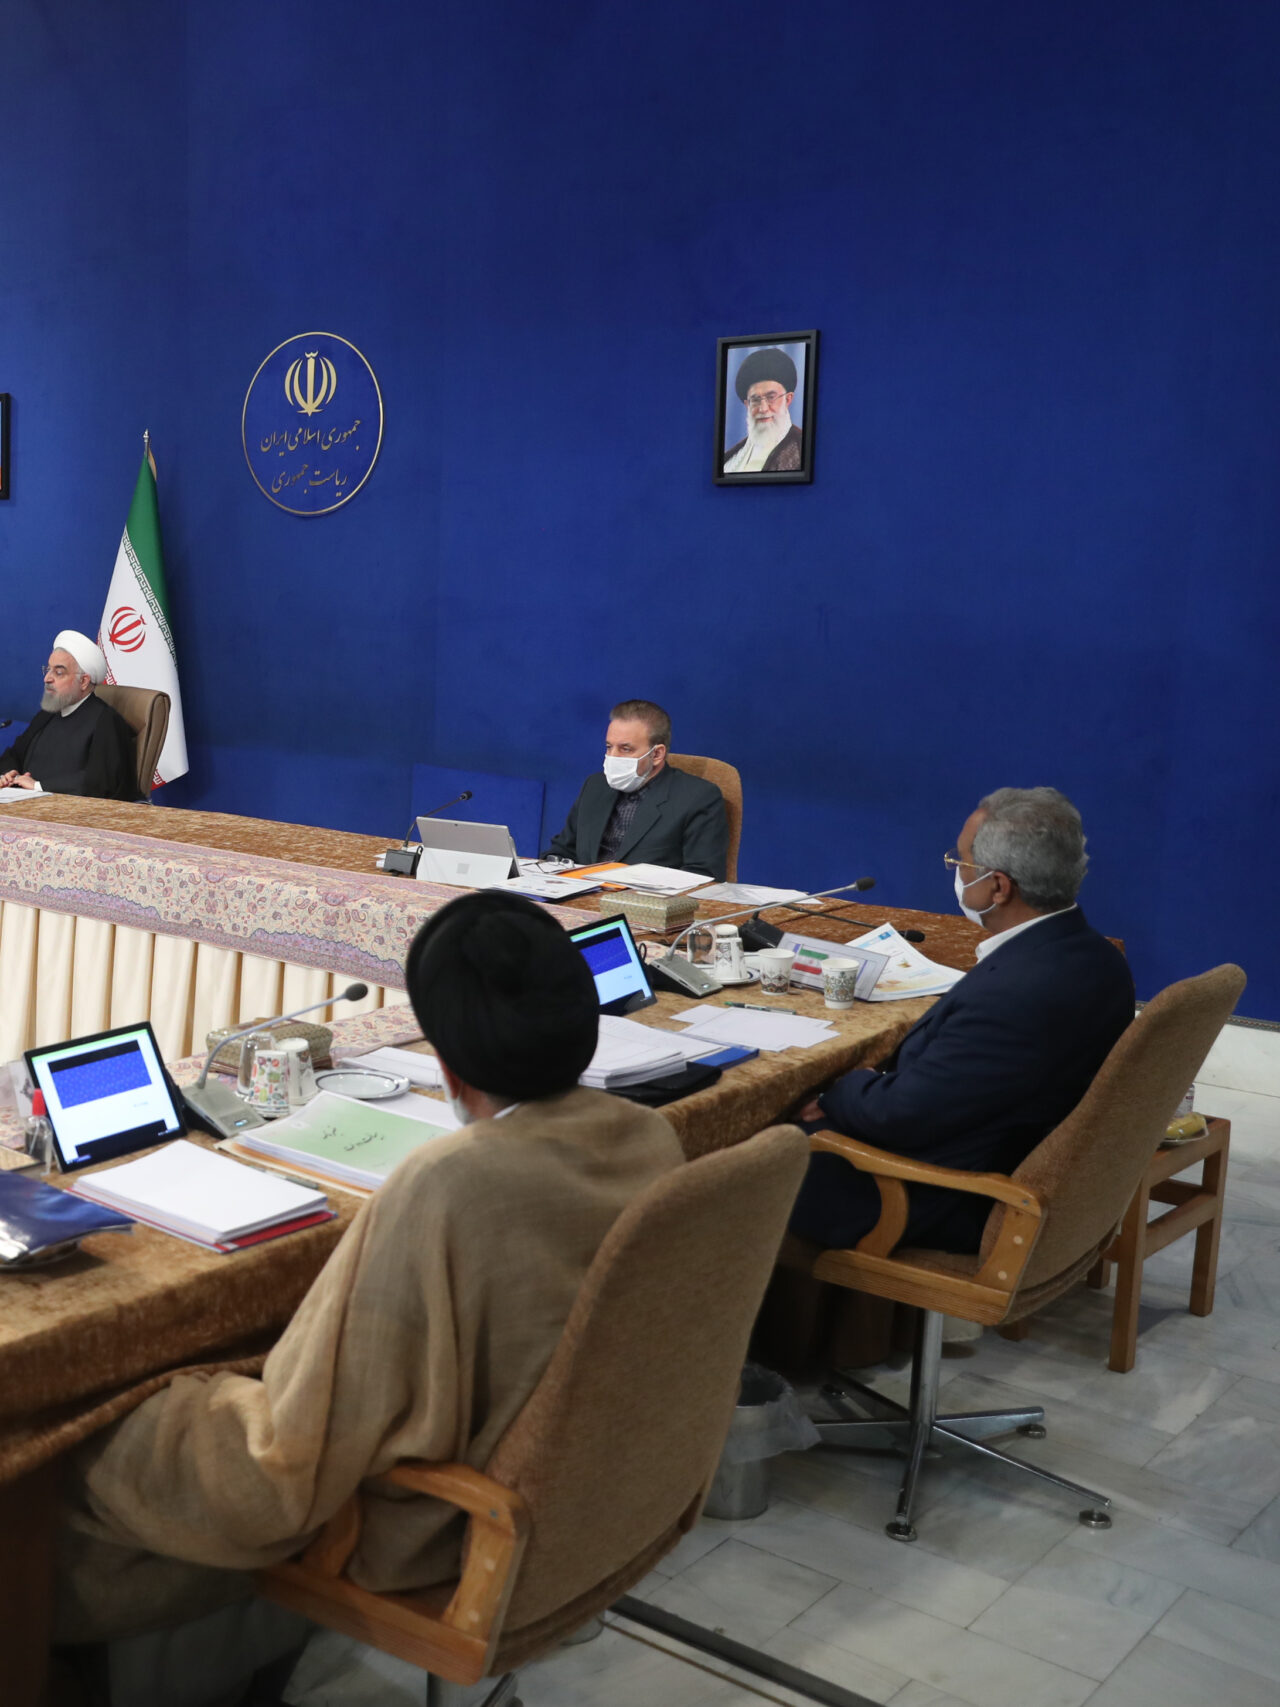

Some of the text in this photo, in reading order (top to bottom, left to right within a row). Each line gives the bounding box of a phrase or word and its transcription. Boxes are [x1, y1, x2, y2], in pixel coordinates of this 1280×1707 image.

[260, 420, 361, 457] جمهوری اسلامی ایران
[271, 463, 348, 497] ریاست جمهوری
